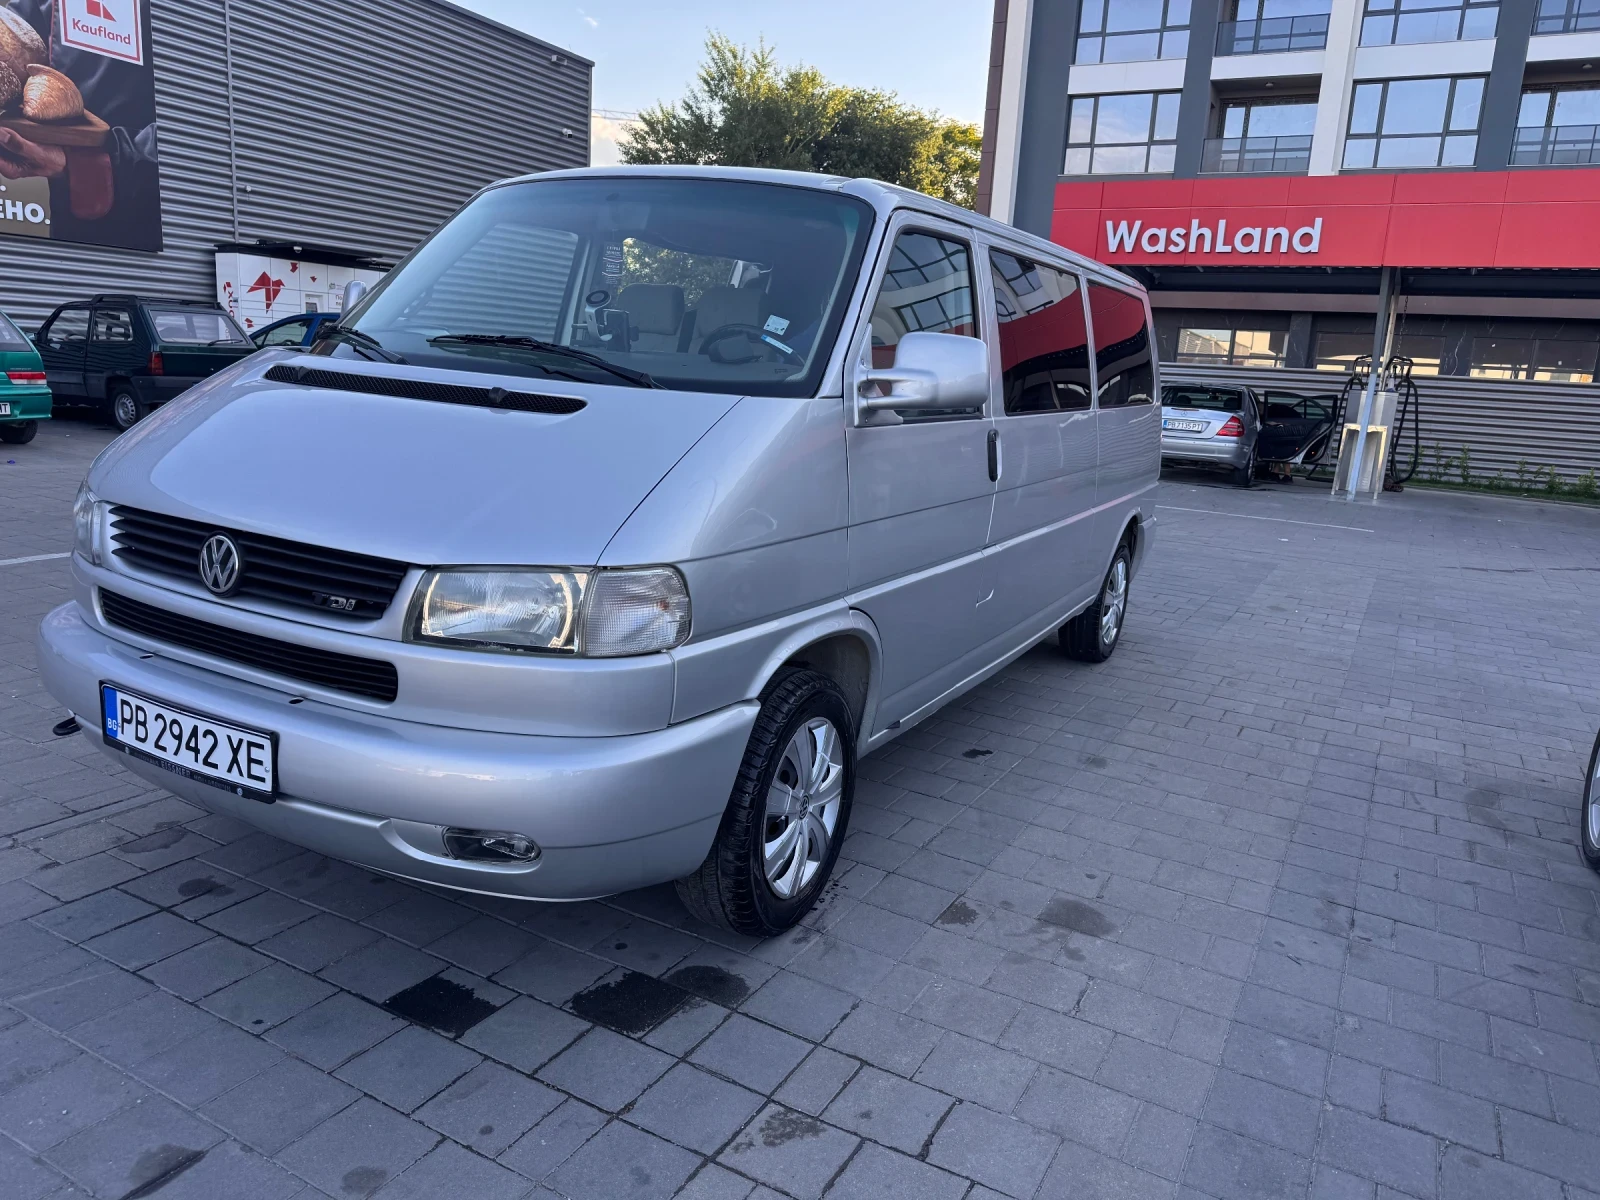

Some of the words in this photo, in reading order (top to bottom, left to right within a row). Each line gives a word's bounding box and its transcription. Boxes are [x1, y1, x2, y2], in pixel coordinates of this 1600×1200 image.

[72, 18, 131, 45] Kaufland
[1105, 217, 1323, 253] WashLand
[107, 717, 118, 731] BG
[120, 698, 148, 743] PB
[154, 713, 219, 770] 2942
[226, 734, 266, 783] XE
